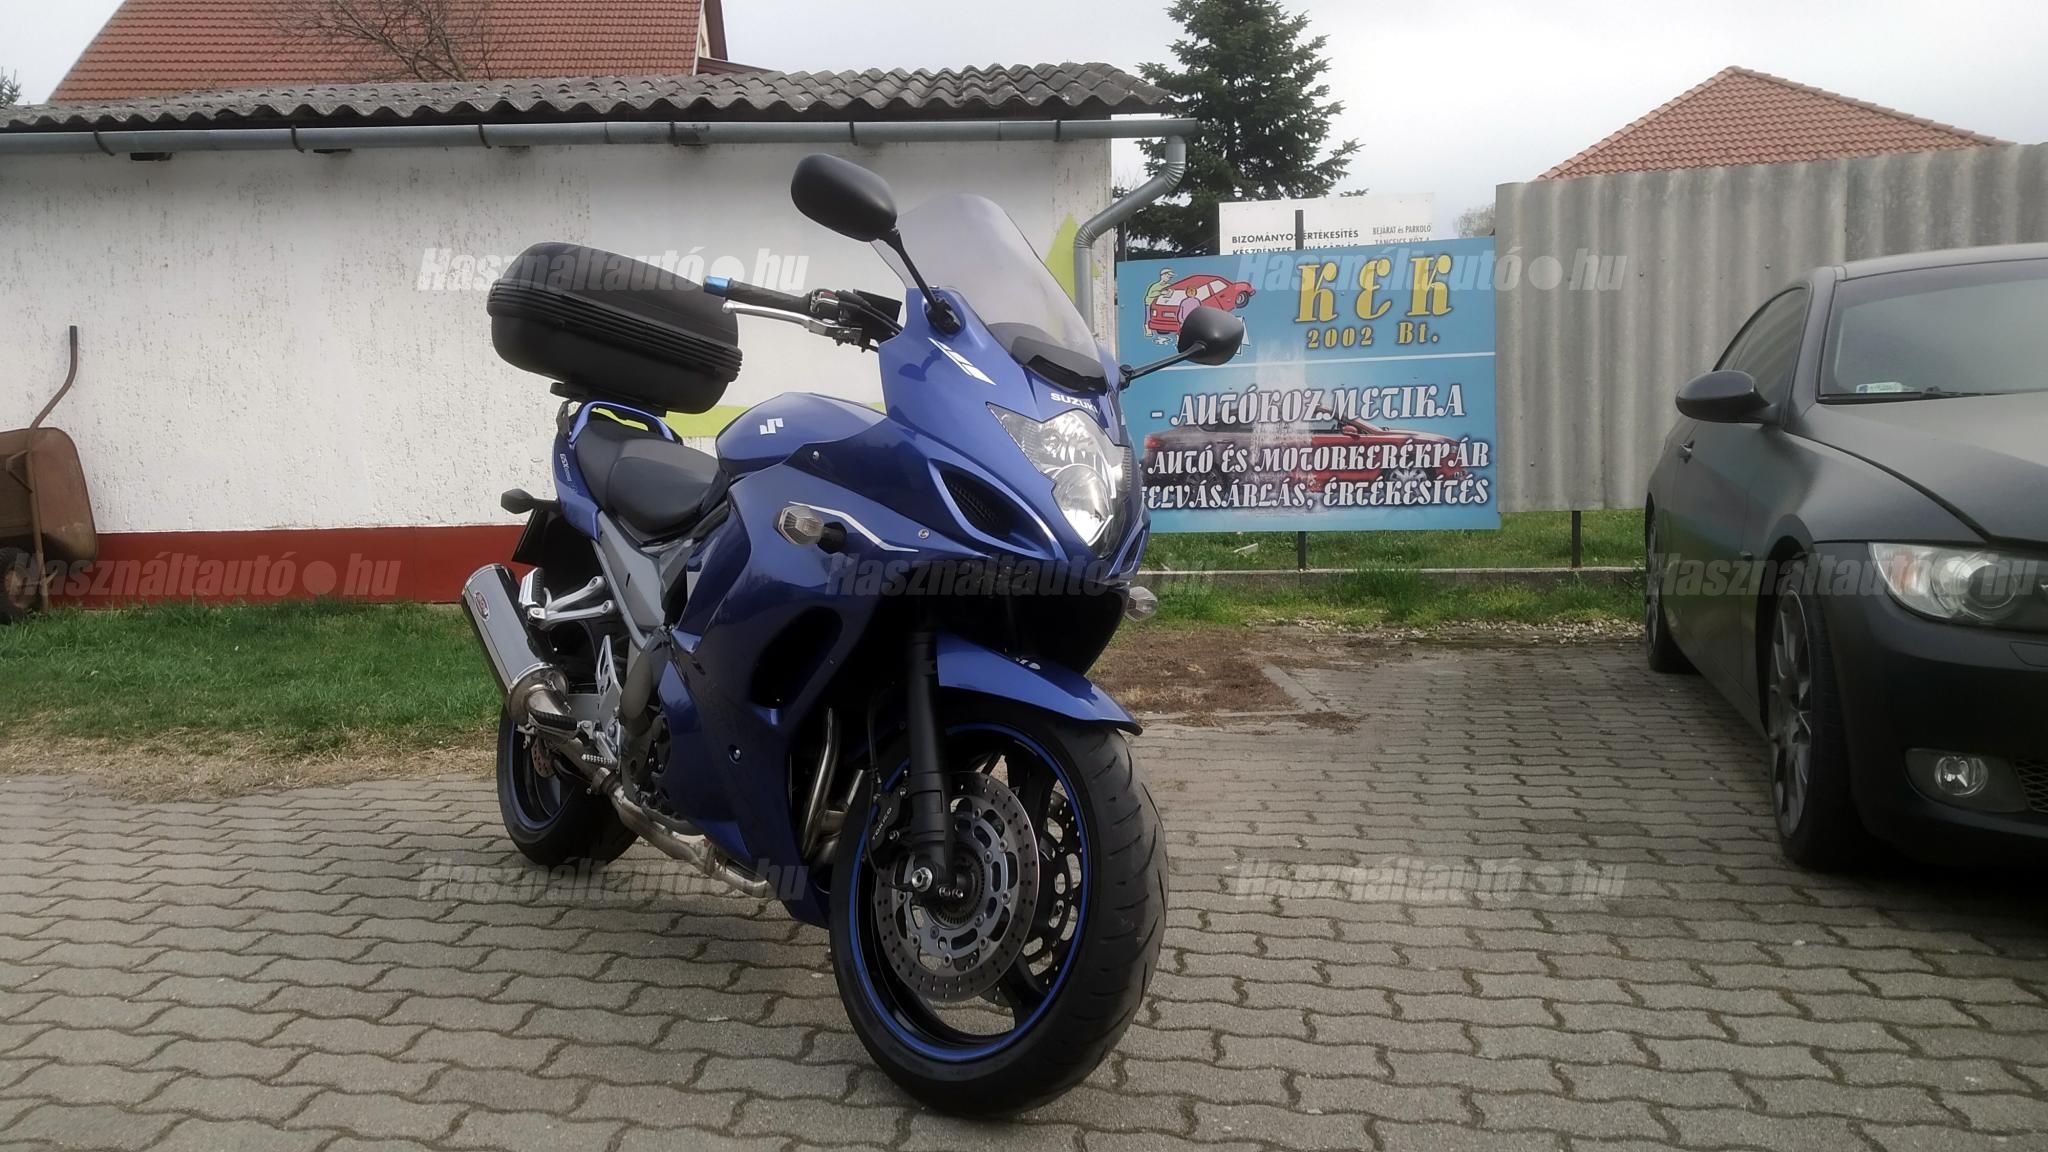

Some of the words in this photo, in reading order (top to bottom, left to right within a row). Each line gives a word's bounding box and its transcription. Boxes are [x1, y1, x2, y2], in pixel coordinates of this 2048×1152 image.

[1231, 232, 1297, 244] BIZOMÁNYO
[1307, 326, 1374, 349] 2002
[1398, 321, 1440, 345] Bt.
[1050, 392, 1099, 414] SUZUKI
[1170, 384, 1465, 426] AUTÓKOZMETIKA
[1147, 444, 1214, 475] AUTÓ
[1220, 444, 1248, 473] ÉS
[1254, 436, 1490, 473] MOTORKERÉKPÁR
[1323, 473, 1490, 507] ÉRTÉKESÍTÉS
